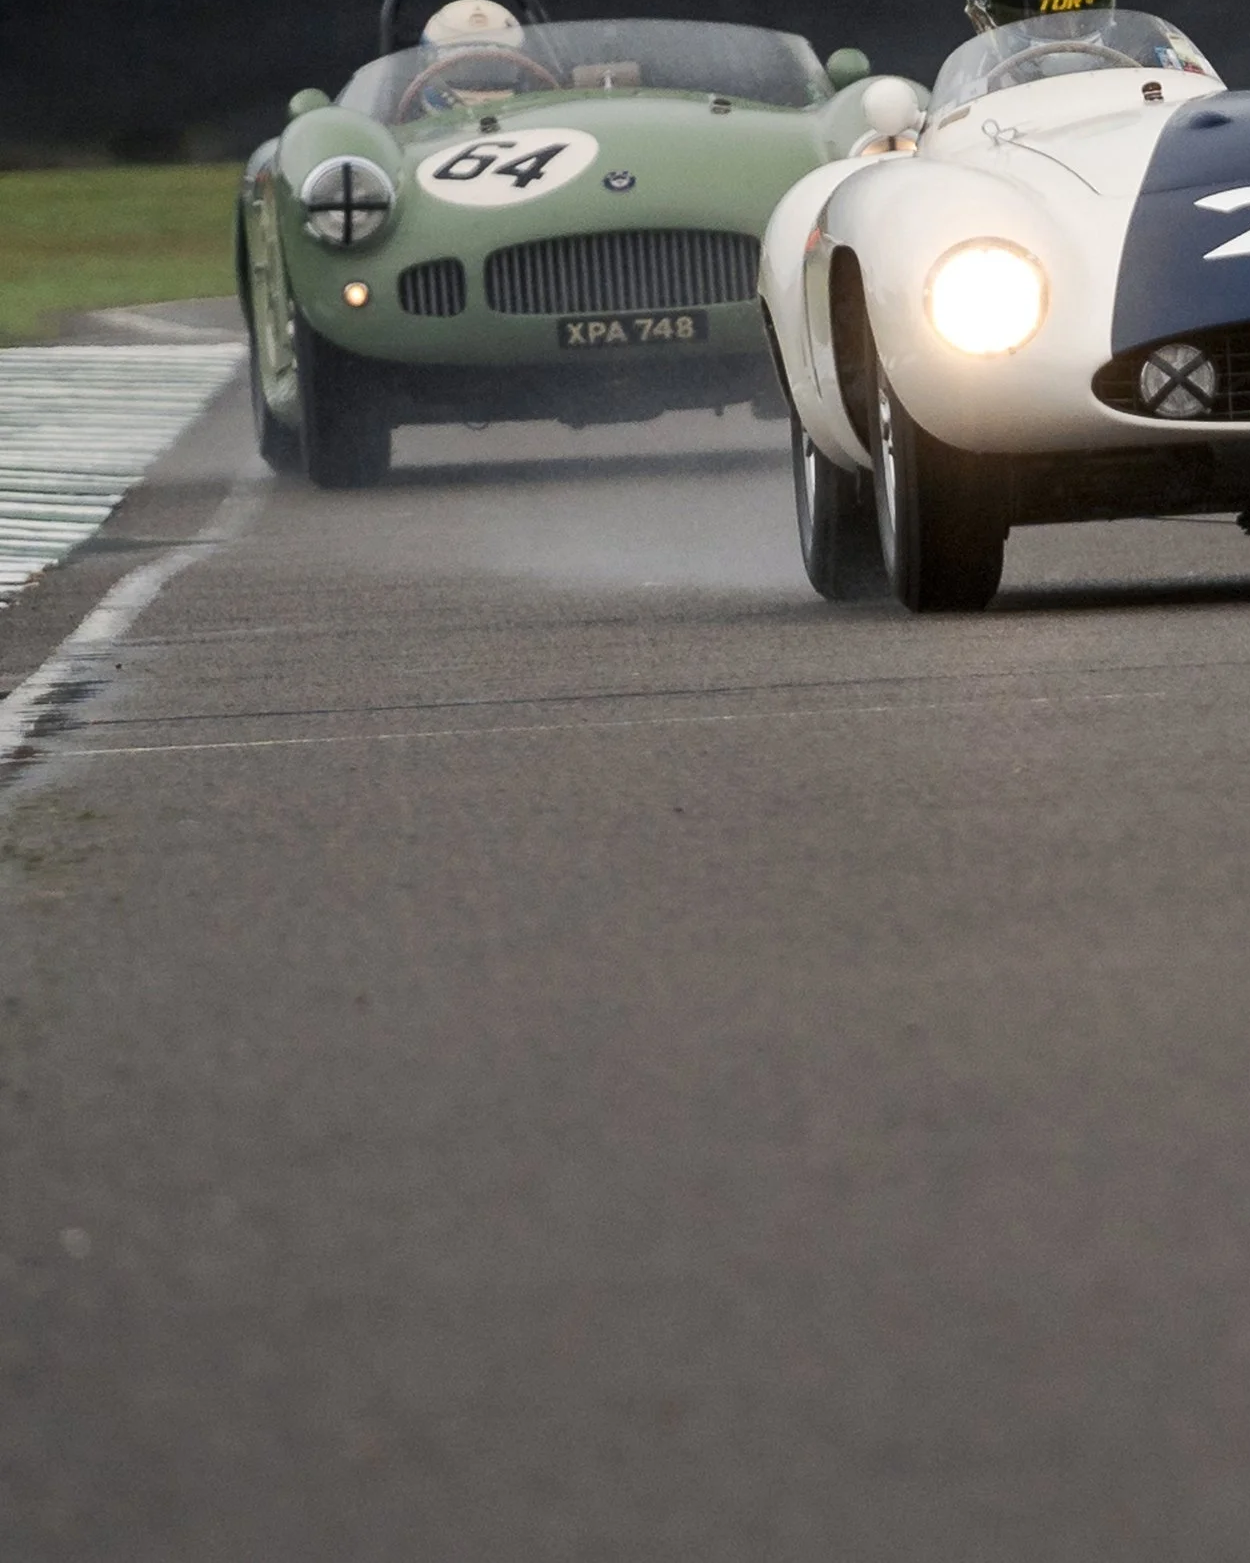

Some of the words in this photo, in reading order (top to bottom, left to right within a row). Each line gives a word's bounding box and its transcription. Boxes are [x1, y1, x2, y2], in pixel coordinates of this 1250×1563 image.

[432, 141, 570, 188] 64
[567, 320, 629, 347] XPA
[634, 315, 695, 342] 748
